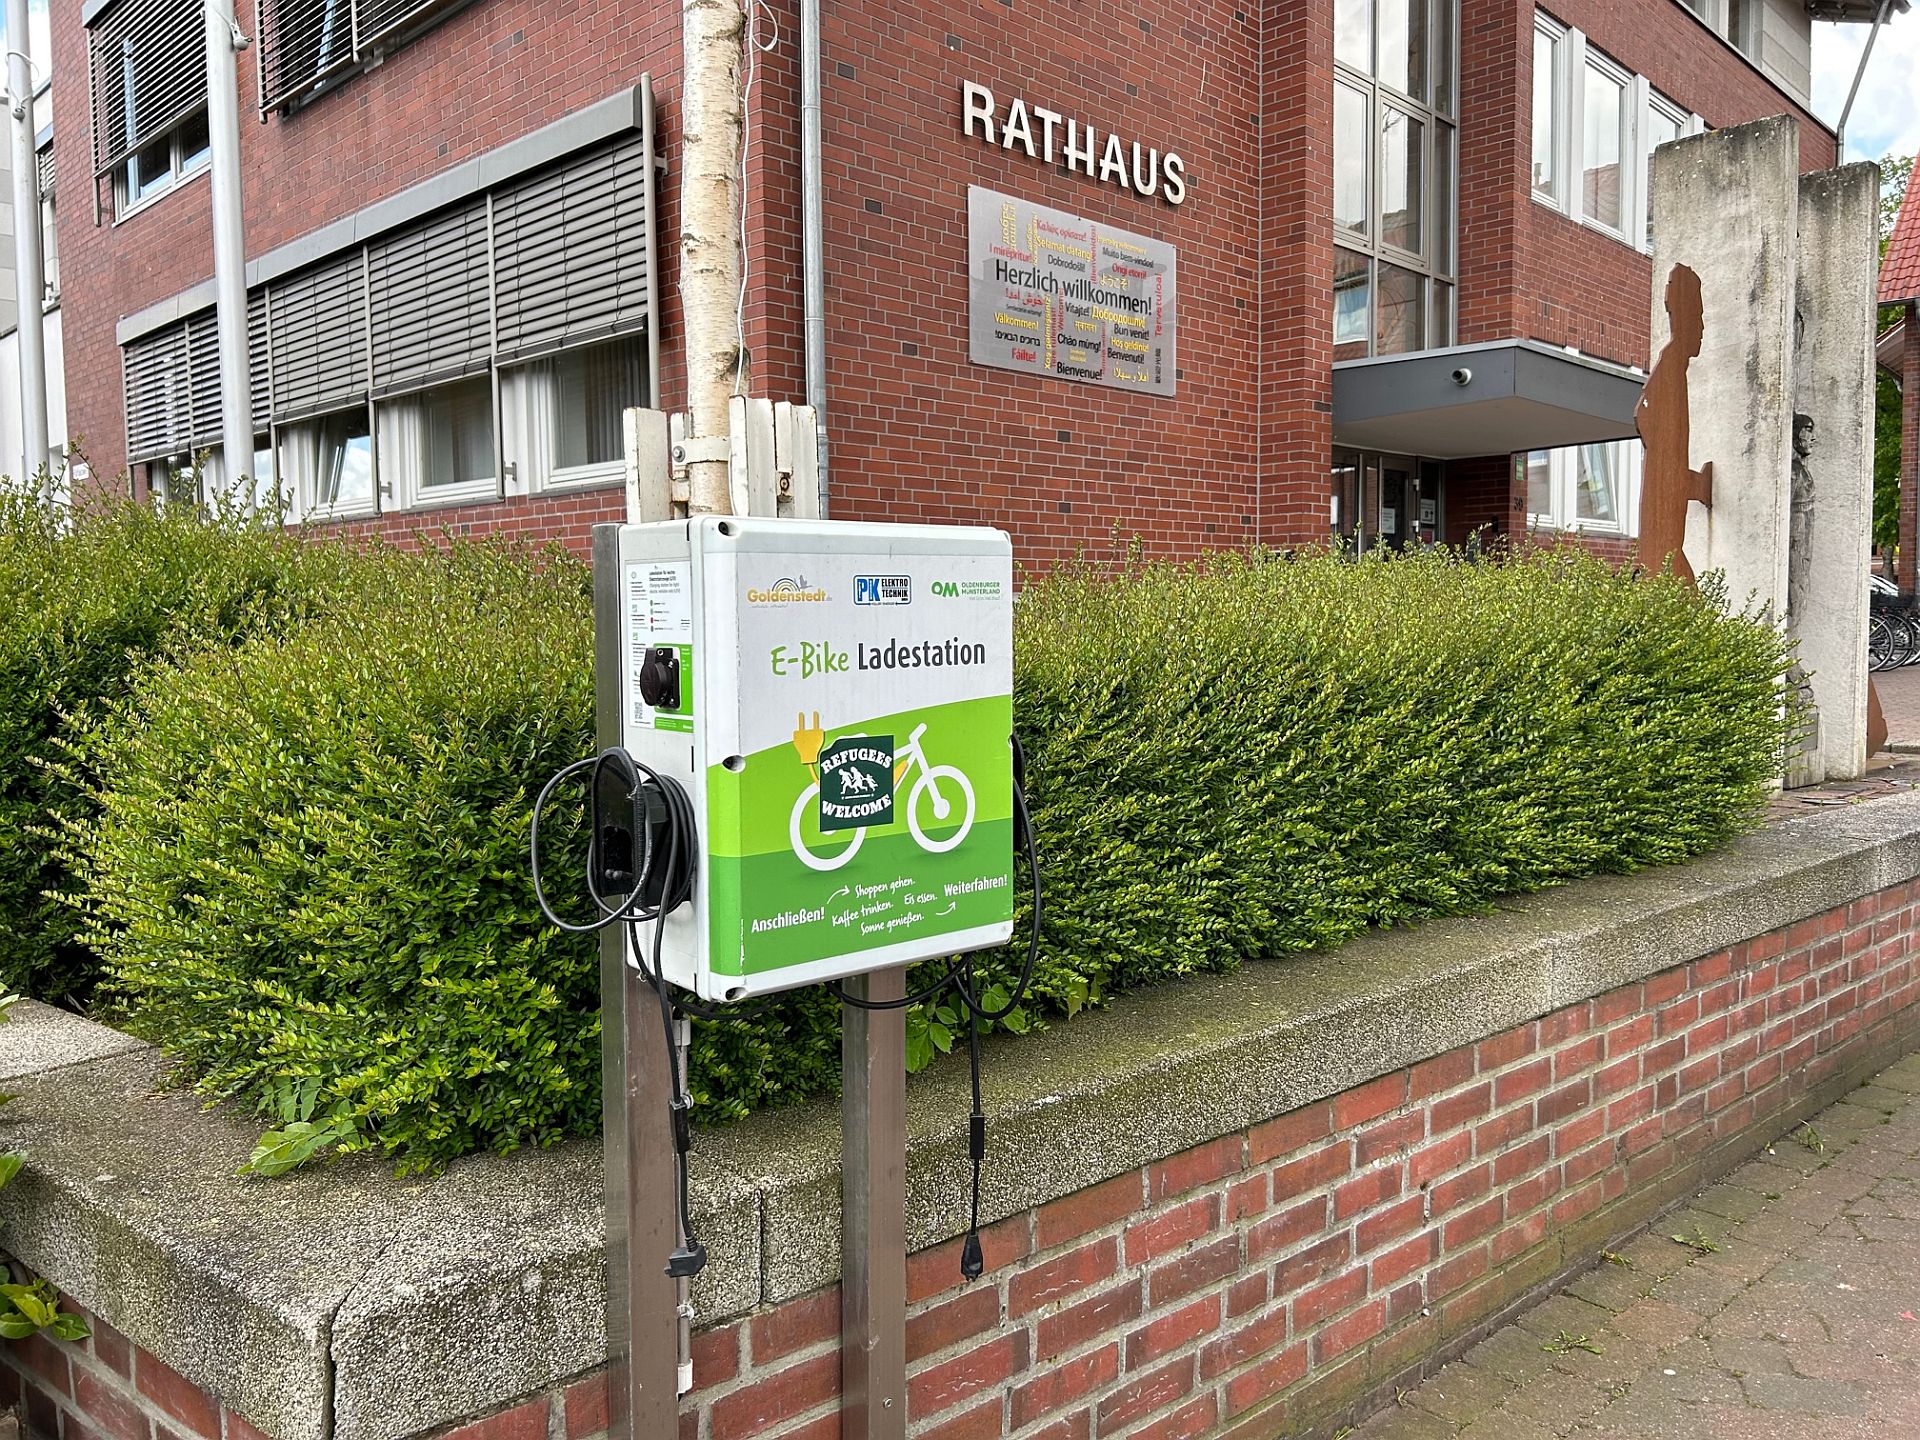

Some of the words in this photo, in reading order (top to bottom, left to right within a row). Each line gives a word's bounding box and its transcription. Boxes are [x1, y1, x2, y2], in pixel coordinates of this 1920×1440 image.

[963, 79, 1186, 204] RATHAUS
[1103, 247, 1119, 259] Muito
[1112, 262, 1127, 277] Ongi
[996, 259, 1059, 294] Herzlich
[1062, 279, 1152, 316] willkommen!
[1057, 287, 1065, 331] Welcome!
[1154, 272, 1163, 338] Tervetuloa!
[993, 311, 1040, 332] Välkommen!
[1114, 323, 1129, 337] Bun
[1129, 328, 1150, 341] venit!
[1107, 347, 1145, 365] Benvenuti!
[1056, 361, 1102, 380] Bienvenue!
[857, 578, 880, 602] PK
[881, 578, 908, 587] ELEKTRO
[882, 589, 909, 598] TECHNIK
[770, 640, 850, 680] E-Bike
[858, 636, 986, 671] Ladestation
[820, 748, 893, 775] REFUGEES
[822, 793, 892, 818] WELCOME
[855, 883, 888, 899] Shoppen
[890, 875, 916, 894] gehen.
[943, 874, 1008, 897] Weiterfahren!
[904, 892, 915, 905] Eis
[916, 893, 938, 904] essen.
[751, 906, 825, 933] Anschließen!
[832, 909, 860, 928] Kaffee
[861, 900, 894, 917] trinken.
[861, 921, 885, 936] Sonne
[886, 911, 925, 933] genießen.
